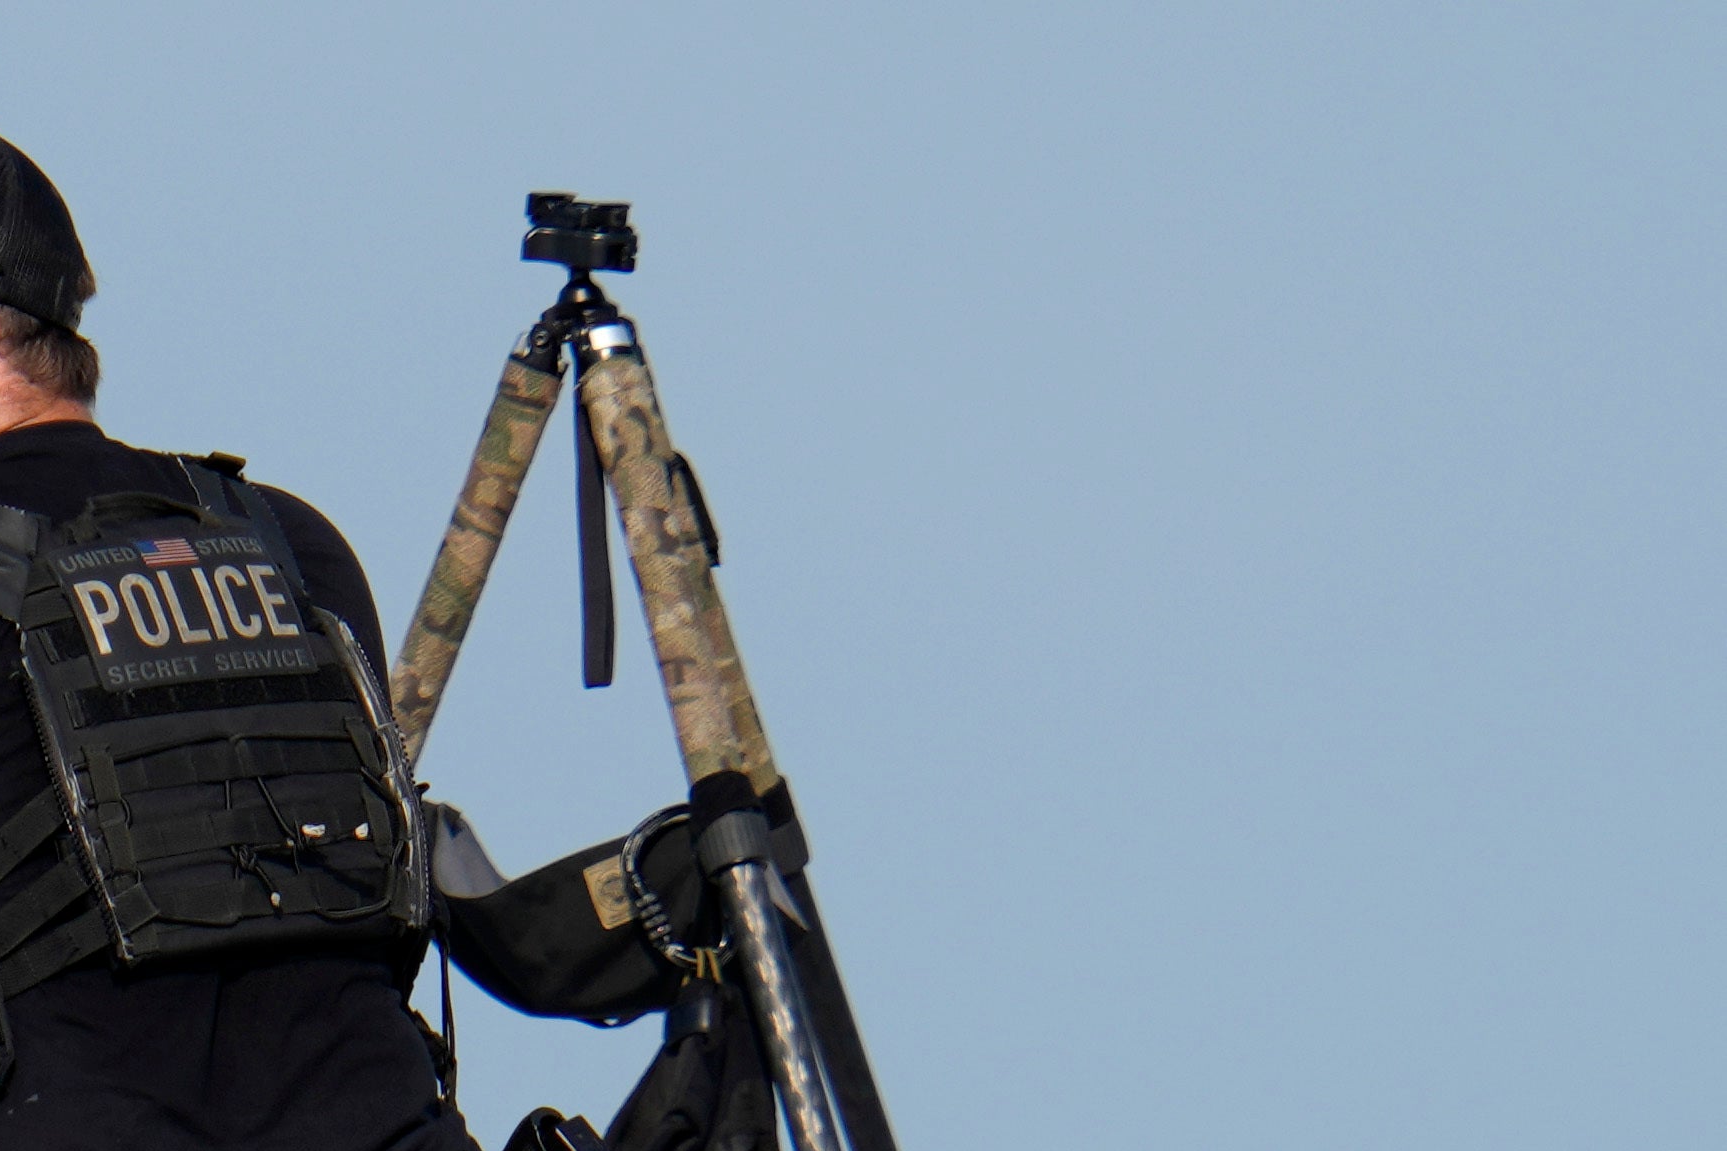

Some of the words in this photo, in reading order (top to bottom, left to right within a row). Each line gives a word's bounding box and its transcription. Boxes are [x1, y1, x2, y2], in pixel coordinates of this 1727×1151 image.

[58, 546, 137, 574] UNITED
[193, 536, 263, 556] STATES
[73, 564, 300, 656] POLICE
[107, 656, 200, 686] SECRET
[214, 648, 310, 672] SERVICE
